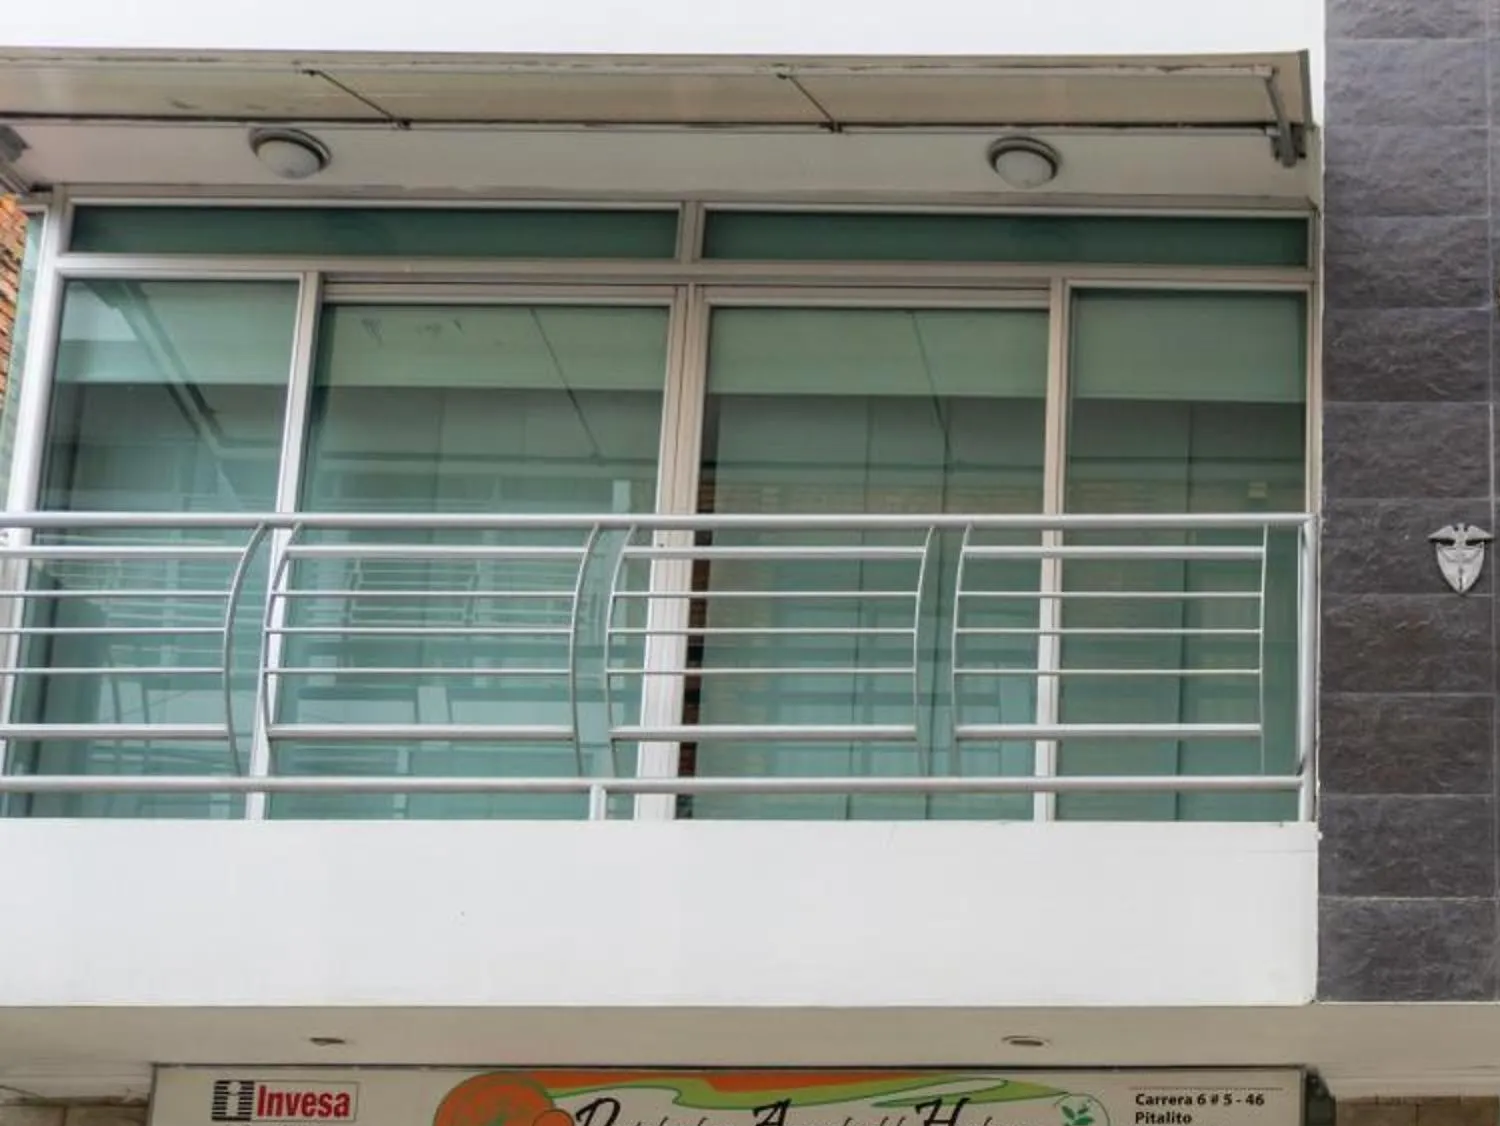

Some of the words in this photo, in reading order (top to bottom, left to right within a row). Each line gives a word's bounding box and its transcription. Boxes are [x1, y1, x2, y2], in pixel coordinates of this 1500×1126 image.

[257, 1086, 351, 1118] Invesa
[1135, 1093, 1193, 1107] Carrera
[1196, 1093, 1207, 1107] 6
[1209, 1093, 1219, 1107] #
[1222, 1093, 1231, 1107] 5
[1245, 1093, 1265, 1107] 46
[1135, 1110, 1193, 1125] Pitalito
